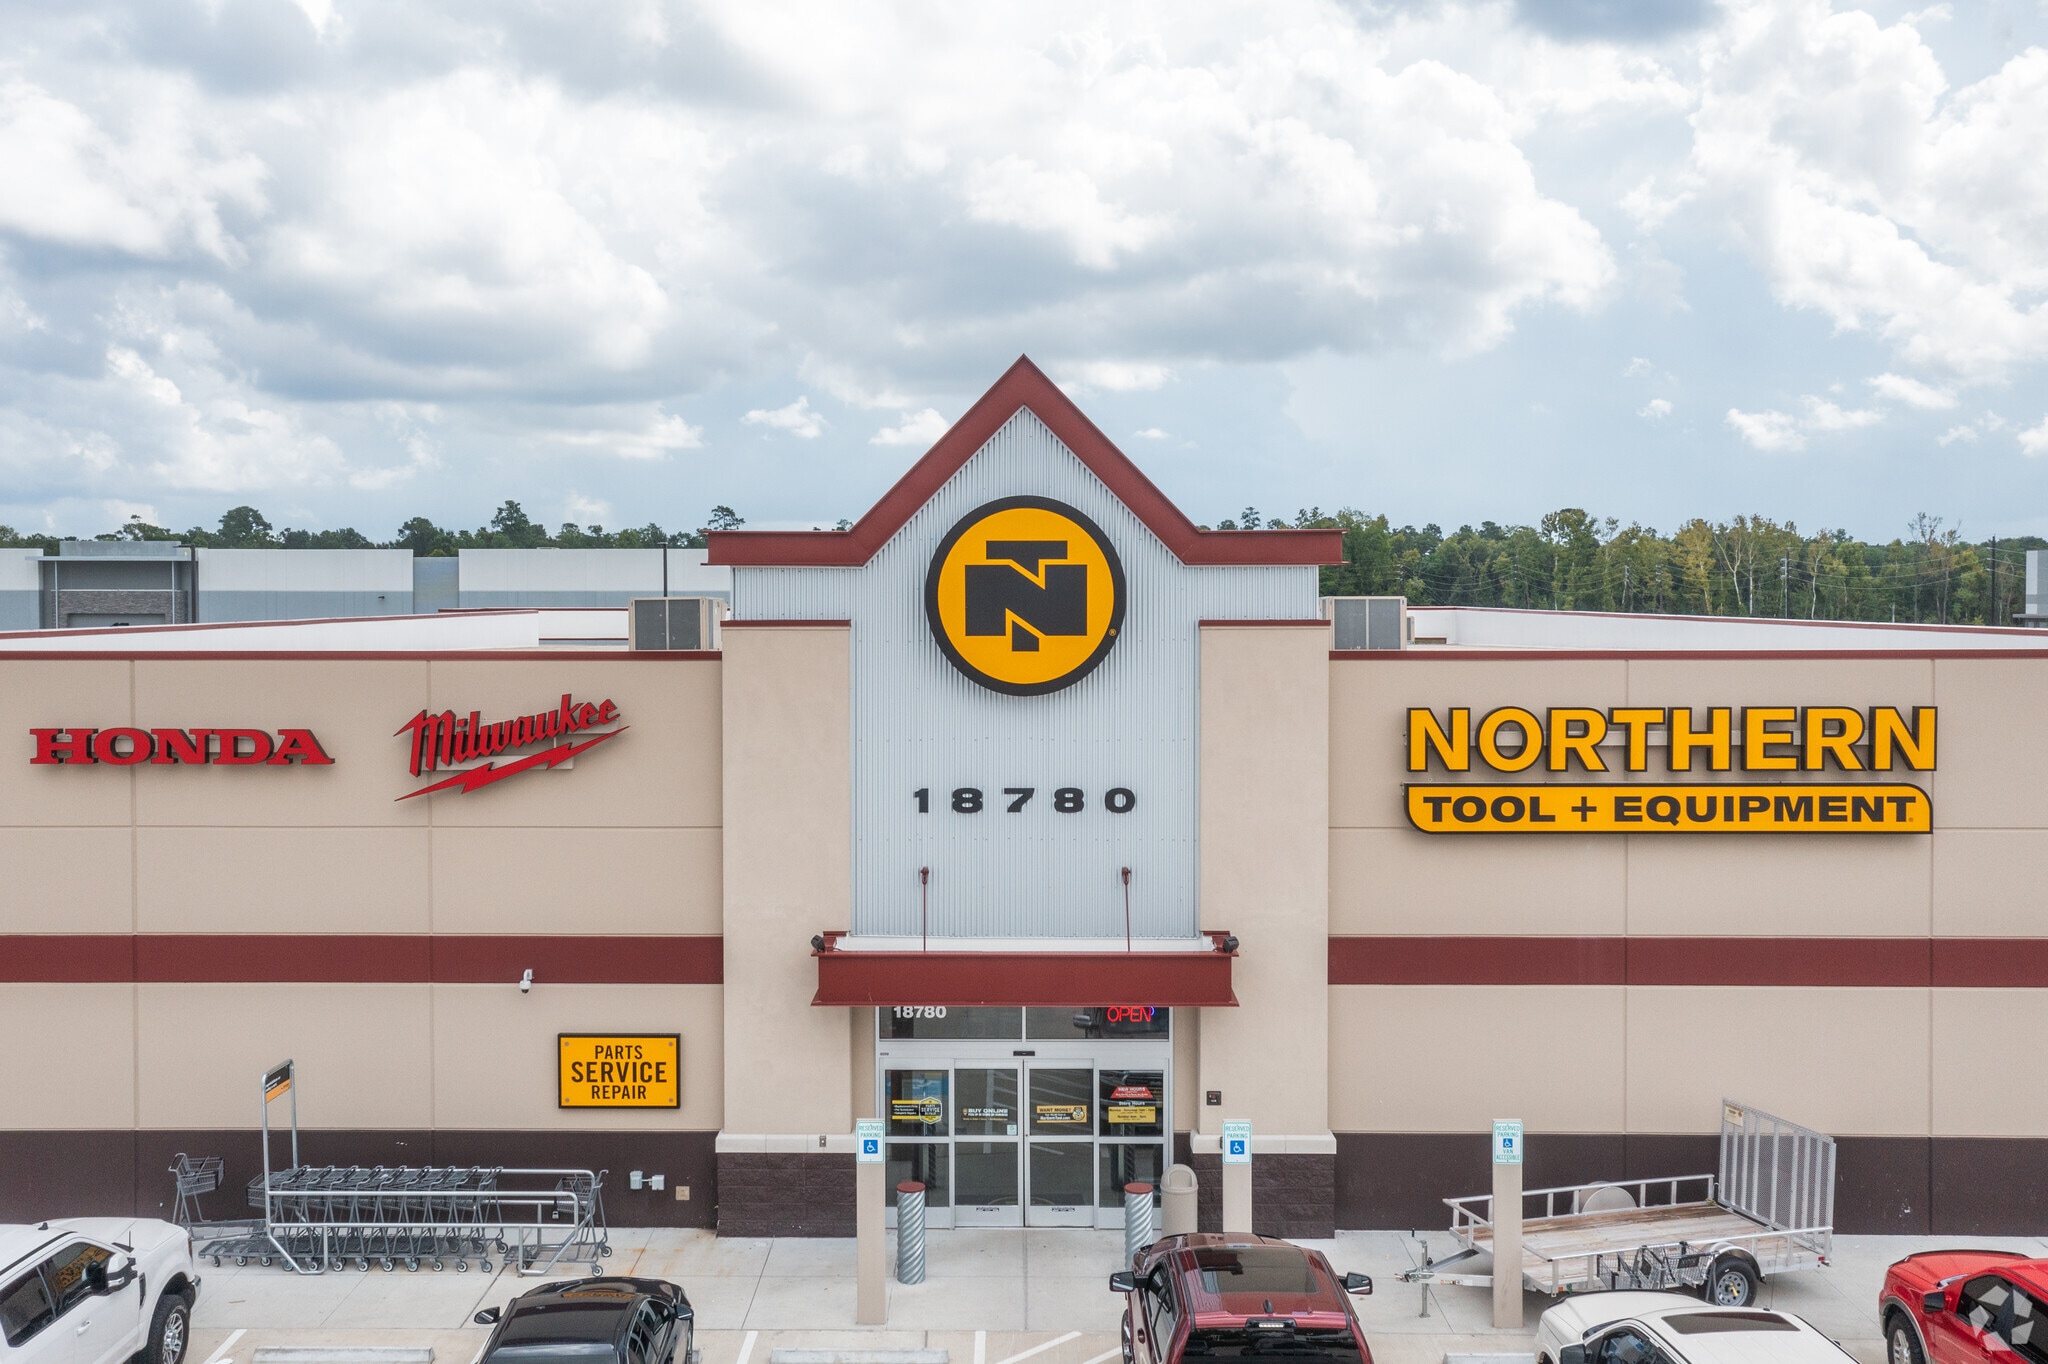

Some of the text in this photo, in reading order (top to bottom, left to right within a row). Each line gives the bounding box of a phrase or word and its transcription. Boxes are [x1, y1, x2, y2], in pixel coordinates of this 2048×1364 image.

[29, 727, 336, 765] HONDA
[393, 693, 621, 778] Milwaukee
[1406, 706, 1938, 772] NORTHERN
[1423, 796, 1555, 823] TOOL
[1614, 795, 1917, 826] EQUIPMENT
[893, 1005, 947, 1019] 18780
[1107, 1005, 1152, 1023] OPEN
[595, 1045, 643, 1060] PARTS
[571, 1061, 667, 1083] SERVICE
[591, 1085, 647, 1100] REPAIR
